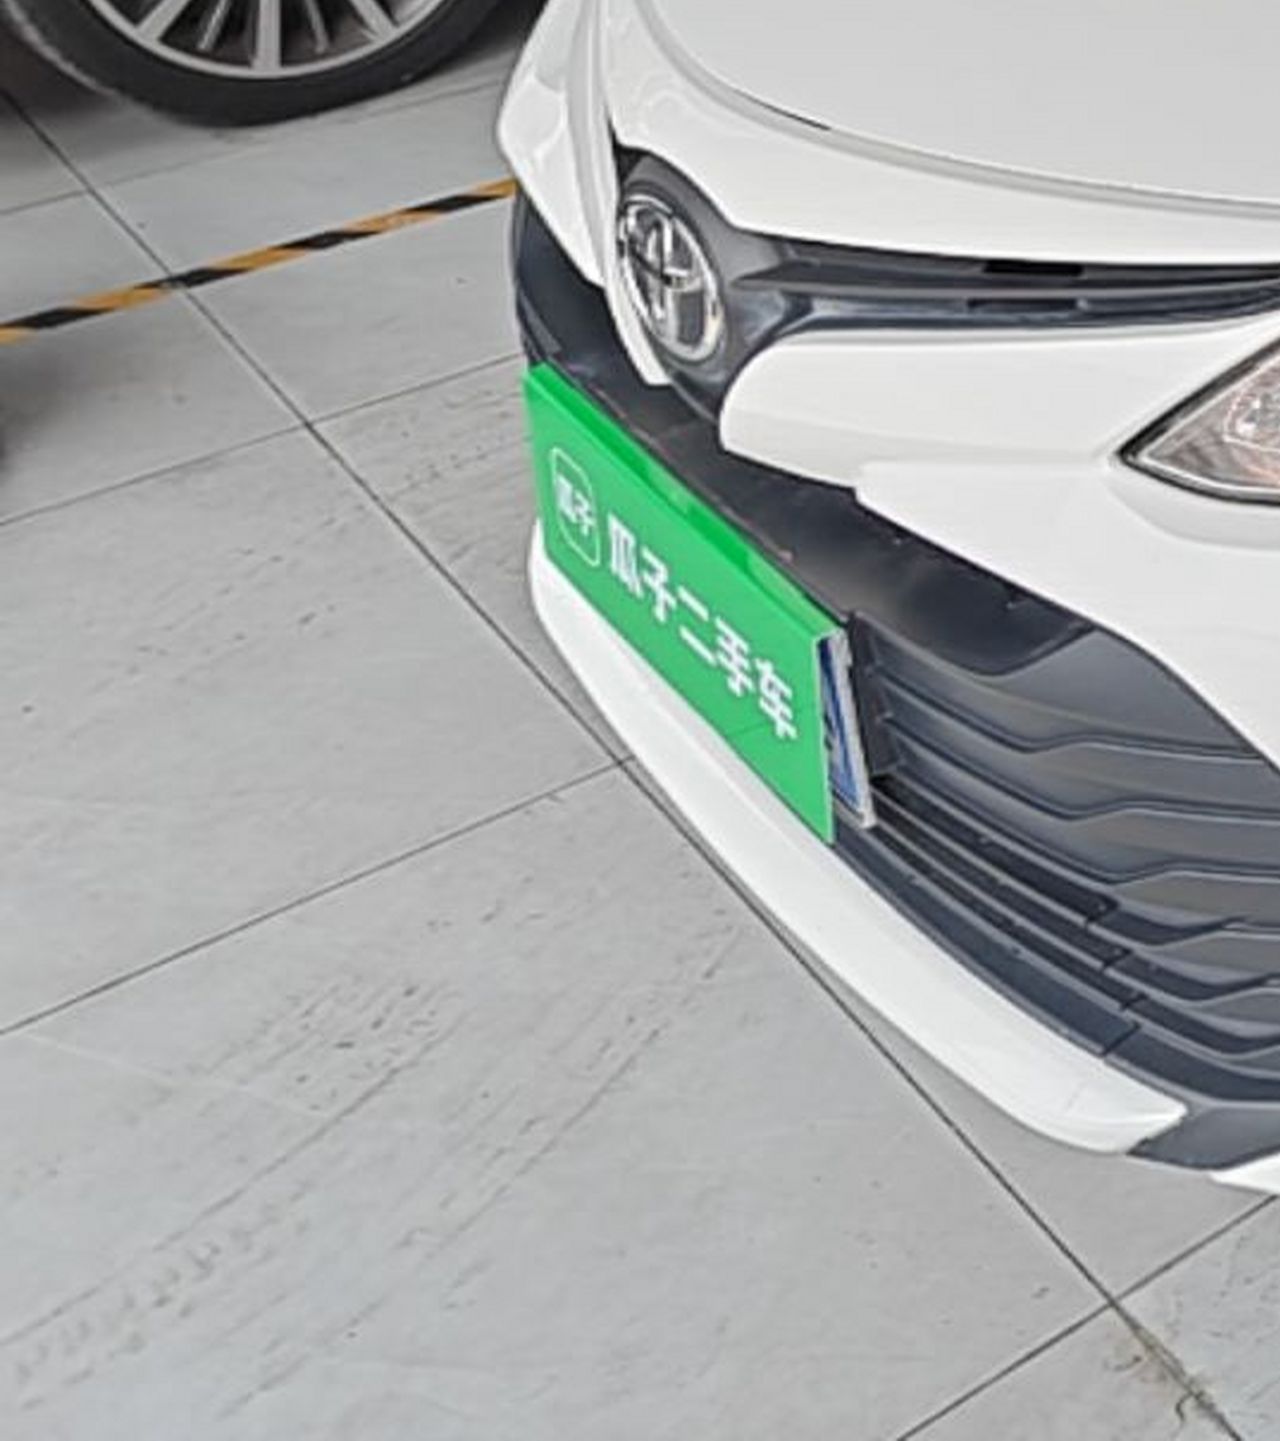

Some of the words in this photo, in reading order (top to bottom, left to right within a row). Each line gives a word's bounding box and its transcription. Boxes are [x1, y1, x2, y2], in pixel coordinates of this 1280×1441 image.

[608, 510, 798, 740] 瓜子二手车
